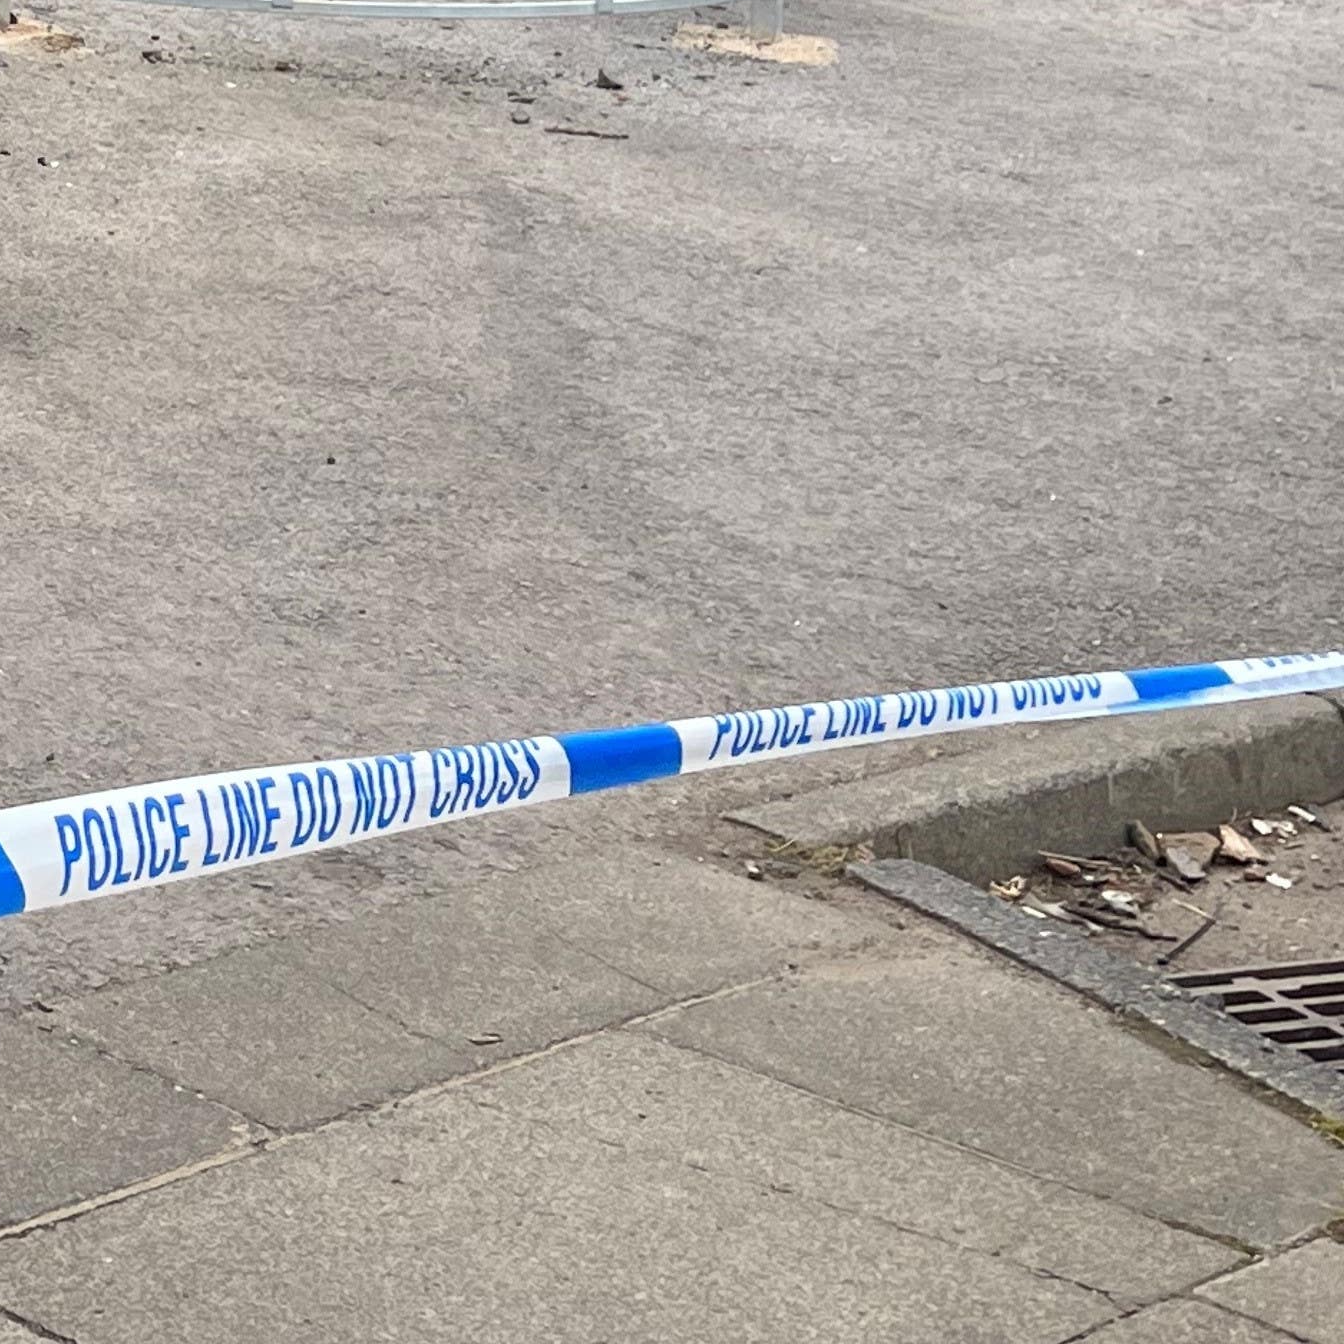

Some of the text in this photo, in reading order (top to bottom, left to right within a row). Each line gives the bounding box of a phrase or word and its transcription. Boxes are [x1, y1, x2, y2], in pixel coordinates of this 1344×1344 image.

[55, 740, 541, 895] POLICE LINE DO NOT CROSS
